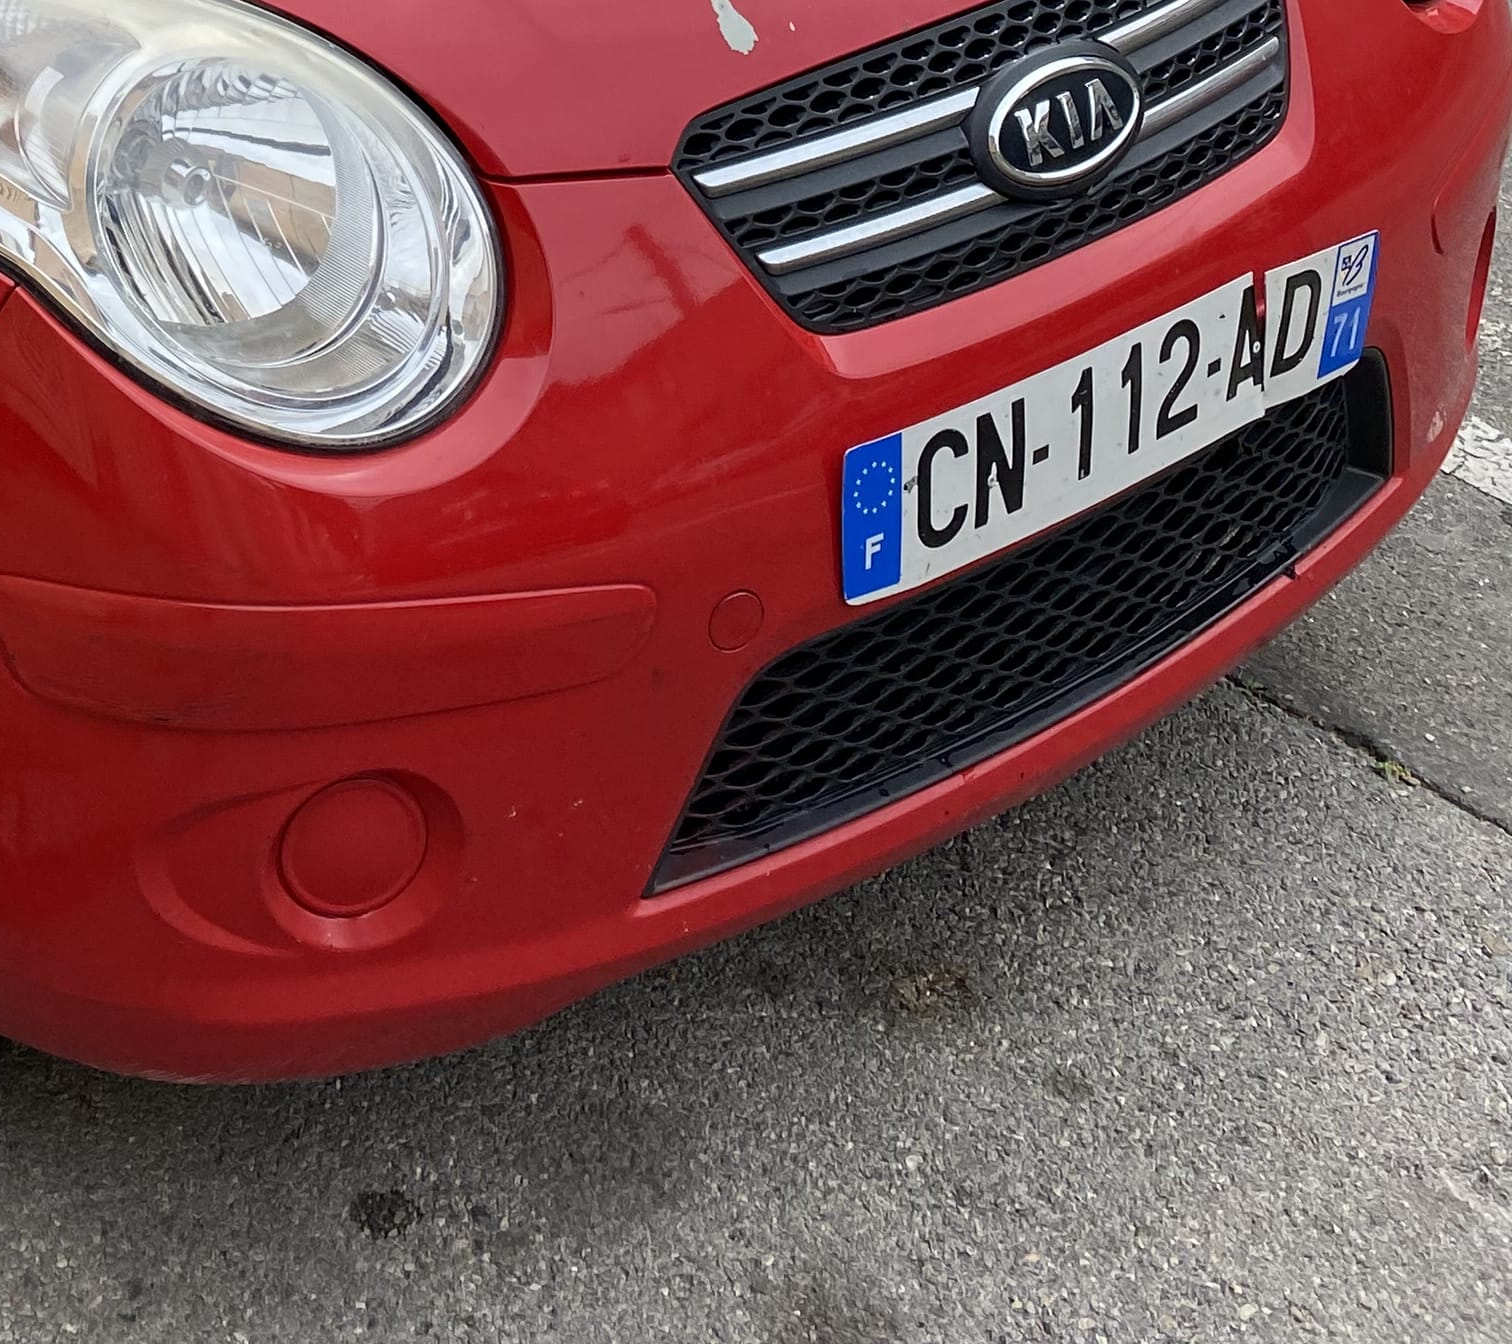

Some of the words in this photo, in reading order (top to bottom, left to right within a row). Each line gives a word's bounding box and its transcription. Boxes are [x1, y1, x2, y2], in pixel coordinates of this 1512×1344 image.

[1013, 78, 1124, 167] KIA
[1330, 305, 1361, 358] 71
[916, 269, 1323, 549] CN-112-AD
[864, 532, 884, 571] F
